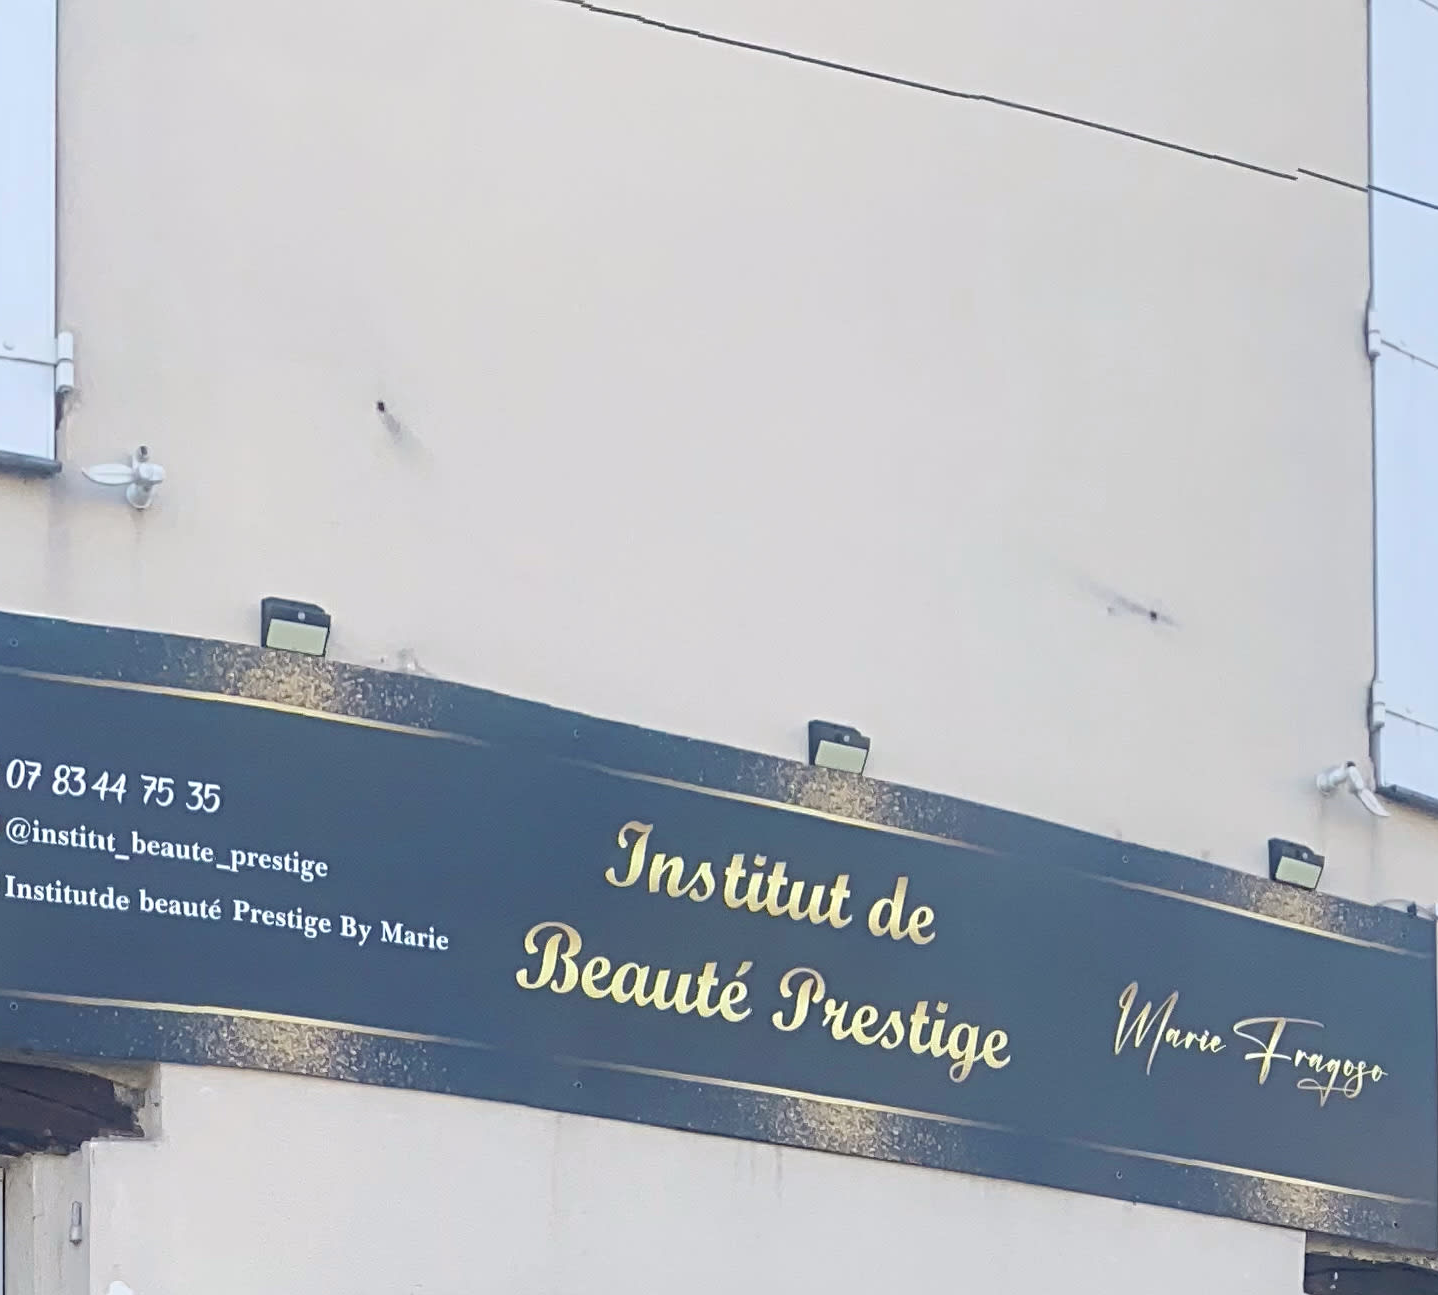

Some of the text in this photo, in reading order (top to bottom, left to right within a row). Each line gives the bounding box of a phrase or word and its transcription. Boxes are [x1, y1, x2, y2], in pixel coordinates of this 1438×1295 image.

[6, 758, 221, 813] 07 83 44 75 35
[5, 816, 329, 882] @institut_beaute_prestige
[604, 820, 936, 945] Institut de
[139, 888, 222, 921] beauté
[233, 899, 332, 938] Prestige
[339, 914, 372, 946] By
[380, 921, 450, 951] Marie
[515, 921, 1010, 1083] Beauté Prestige
[1114, 980, 1389, 1107] Marie Fragoso
